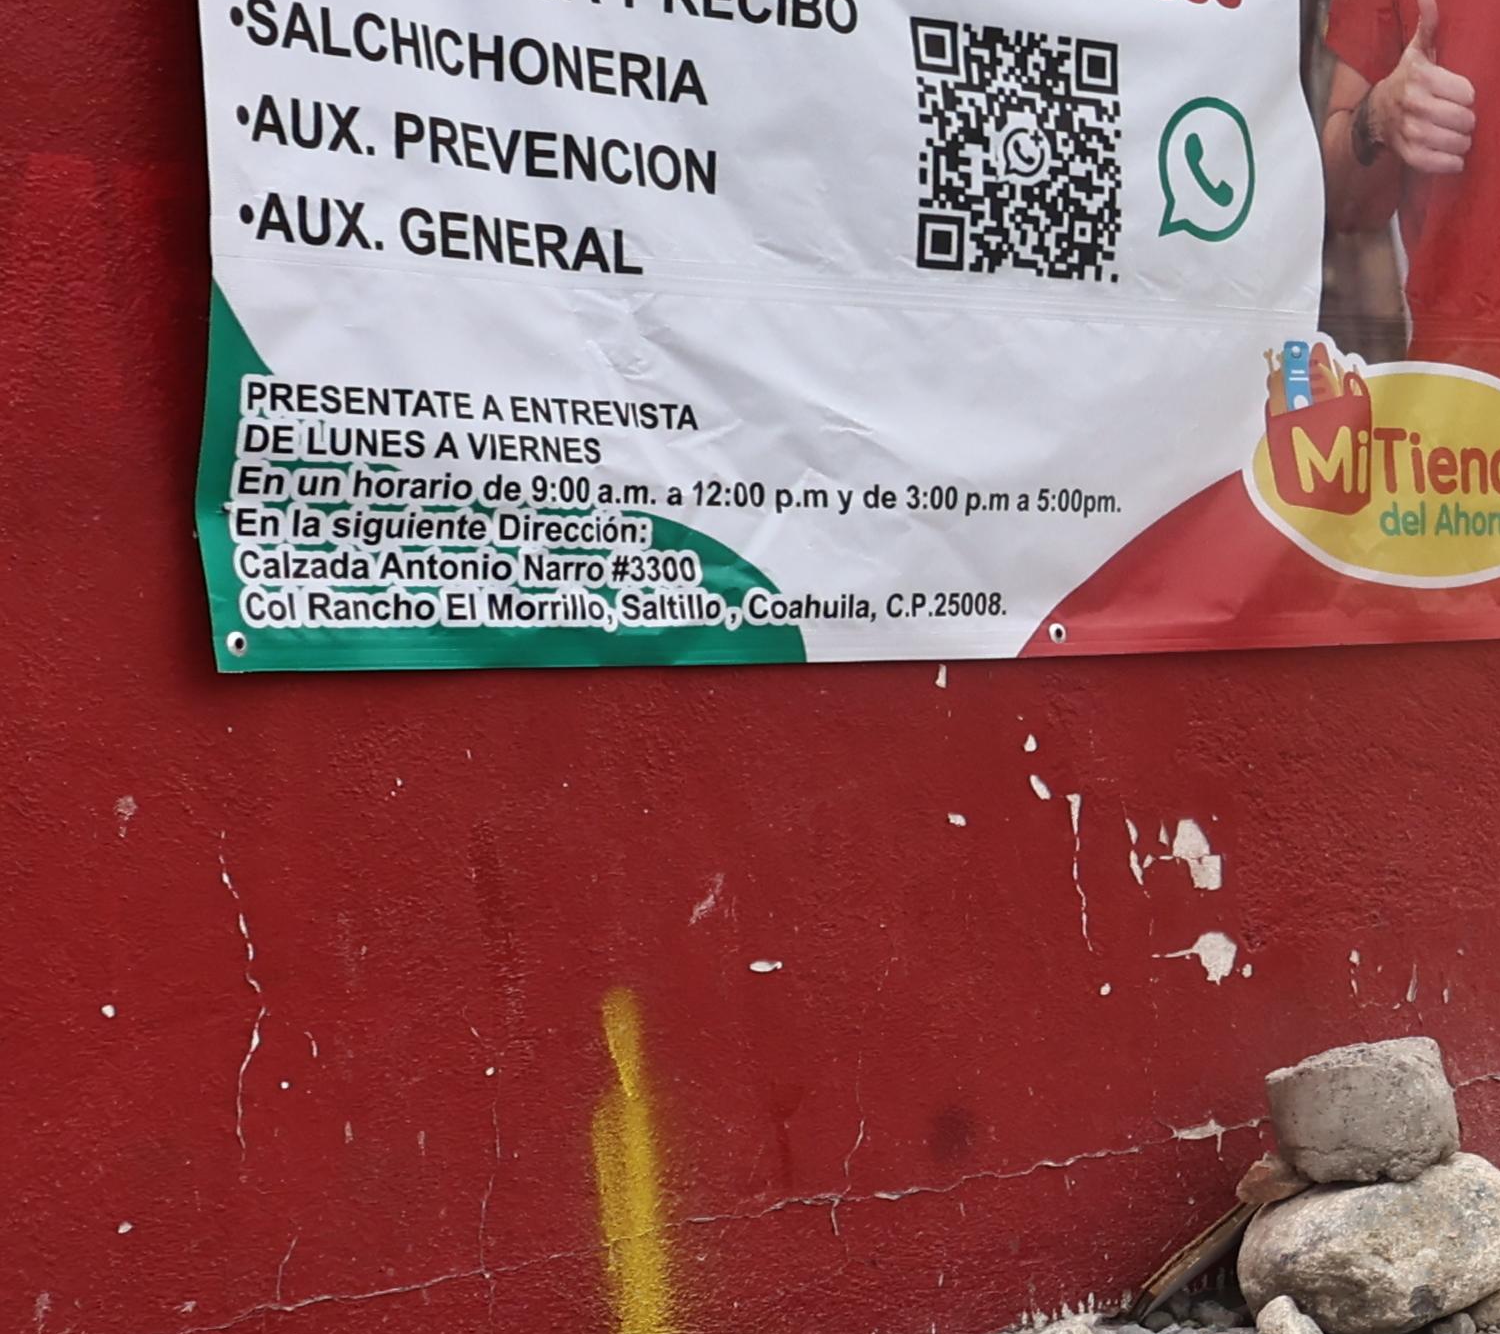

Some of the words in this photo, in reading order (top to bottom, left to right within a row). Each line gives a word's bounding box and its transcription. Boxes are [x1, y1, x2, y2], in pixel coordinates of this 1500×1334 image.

[395, 110, 717, 194] PREVENCION
[400, 207, 643, 275] GENERAL
[247, 382, 474, 420] PRESENTATE
[482, 394, 501, 420] A
[510, 396, 698, 430] ENTREVISTA
[243, 424, 294, 454] DE
[308, 427, 425, 458] LUNES
[434, 431, 459, 460] A
[468, 432, 601, 464] VIERNES
[237, 467, 284, 496] En
[297, 474, 340, 497] un
[353, 470, 472, 500] horario
[483, 474, 521, 502] de
[532, 476, 590, 503] 9:00
[598, 484, 656, 505] a.m.
[667, 486, 683, 506] a
[692, 480, 764, 507] 12:00
[775, 485, 828, 513] p.m
[837, 487, 853, 514] y
[863, 484, 897, 509] de
[906, 485, 957, 511] 3:00
[965, 489, 1010, 516] p.m
[1016, 491, 1029, 512] a
[235, 509, 279, 536] En
[292, 512, 320, 538] la
[332, 512, 487, 545] siguiente
[500, 514, 647, 543] Dirección:
[1380, 502, 1426, 536] del
[239, 550, 369, 580] Calzada
[380, 552, 512, 581] Antonio
[524, 554, 601, 582] Narro
[611, 554, 697, 583] #3300
[245, 592, 295, 621] Col
[309, 592, 435, 621] Rancho
[447, 592, 477, 621] El
[489, 592, 613, 626] Morrillo,
[748, 594, 876, 623] Coahuila,
[886, 593, 1007, 619] C.P.25008.
